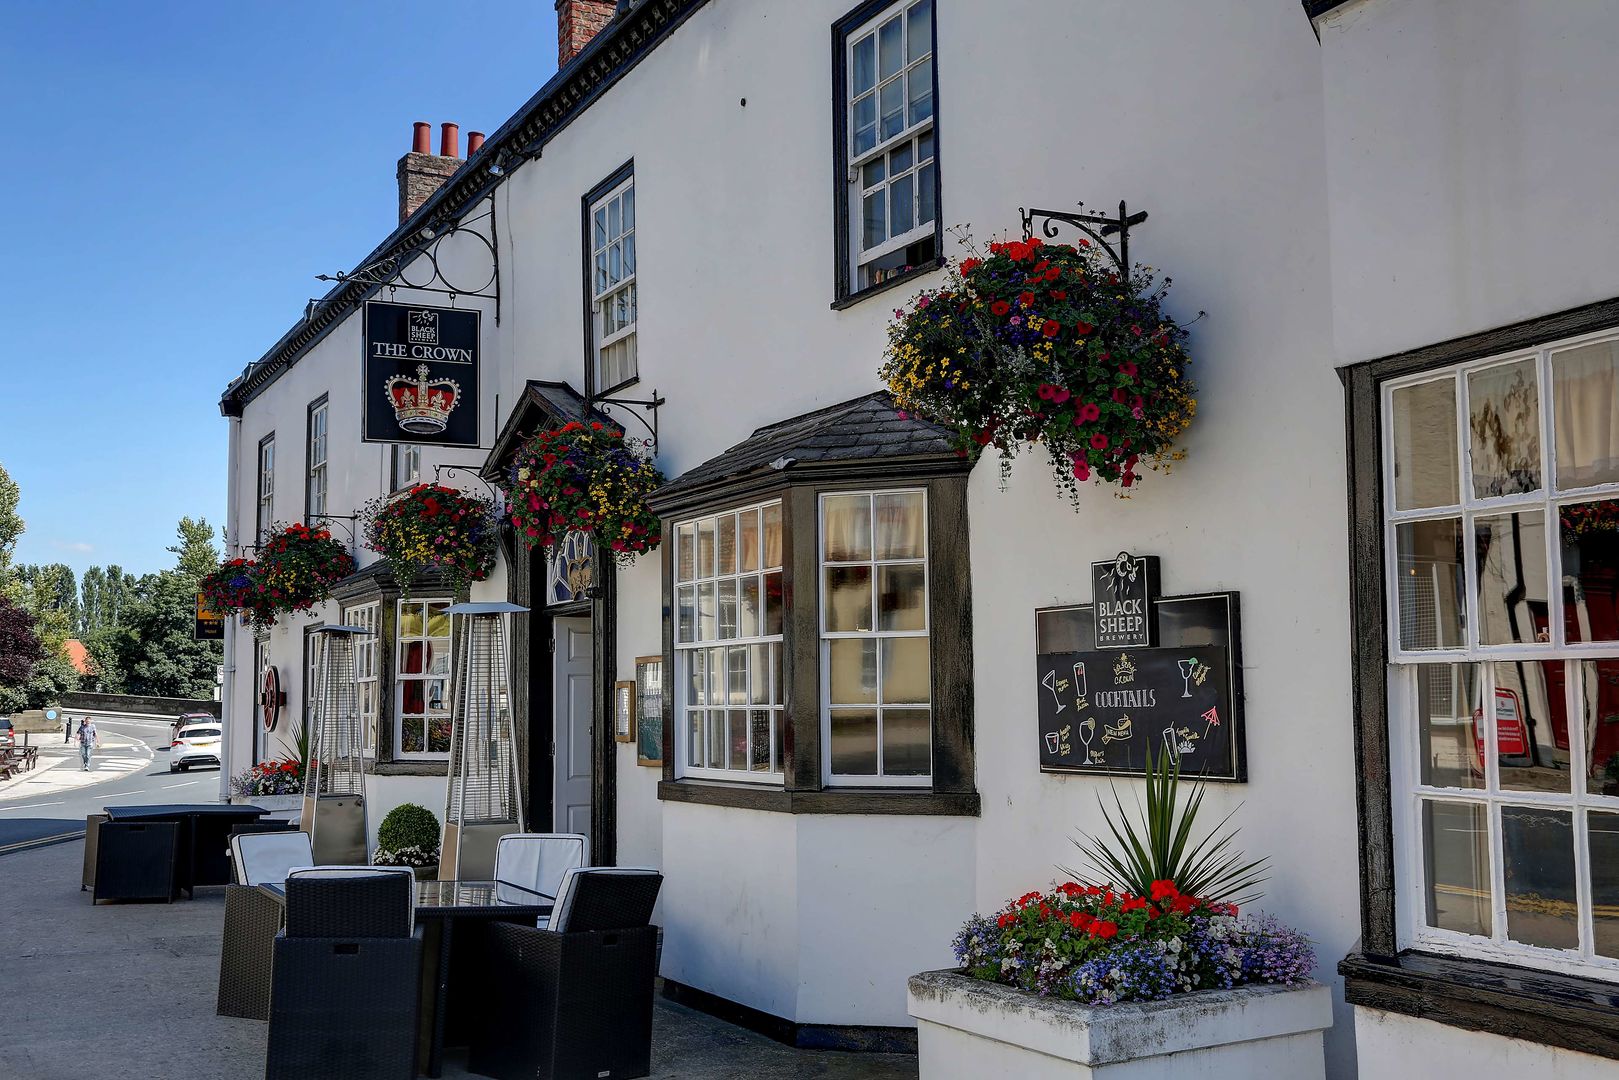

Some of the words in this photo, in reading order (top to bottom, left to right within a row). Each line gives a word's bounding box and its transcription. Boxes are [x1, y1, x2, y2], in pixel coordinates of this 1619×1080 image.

[411, 325, 436, 334] BLACK
[411, 331, 436, 340] SHEEP
[372, 341, 408, 357] THE
[411, 345, 473, 362] CROWN
[1099, 598, 1143, 617] BLACK
[1100, 616, 1143, 634] SHEEP
[1100, 633, 1144, 642] BREWERY
[1095, 689, 1156, 708] COCKTAILS
